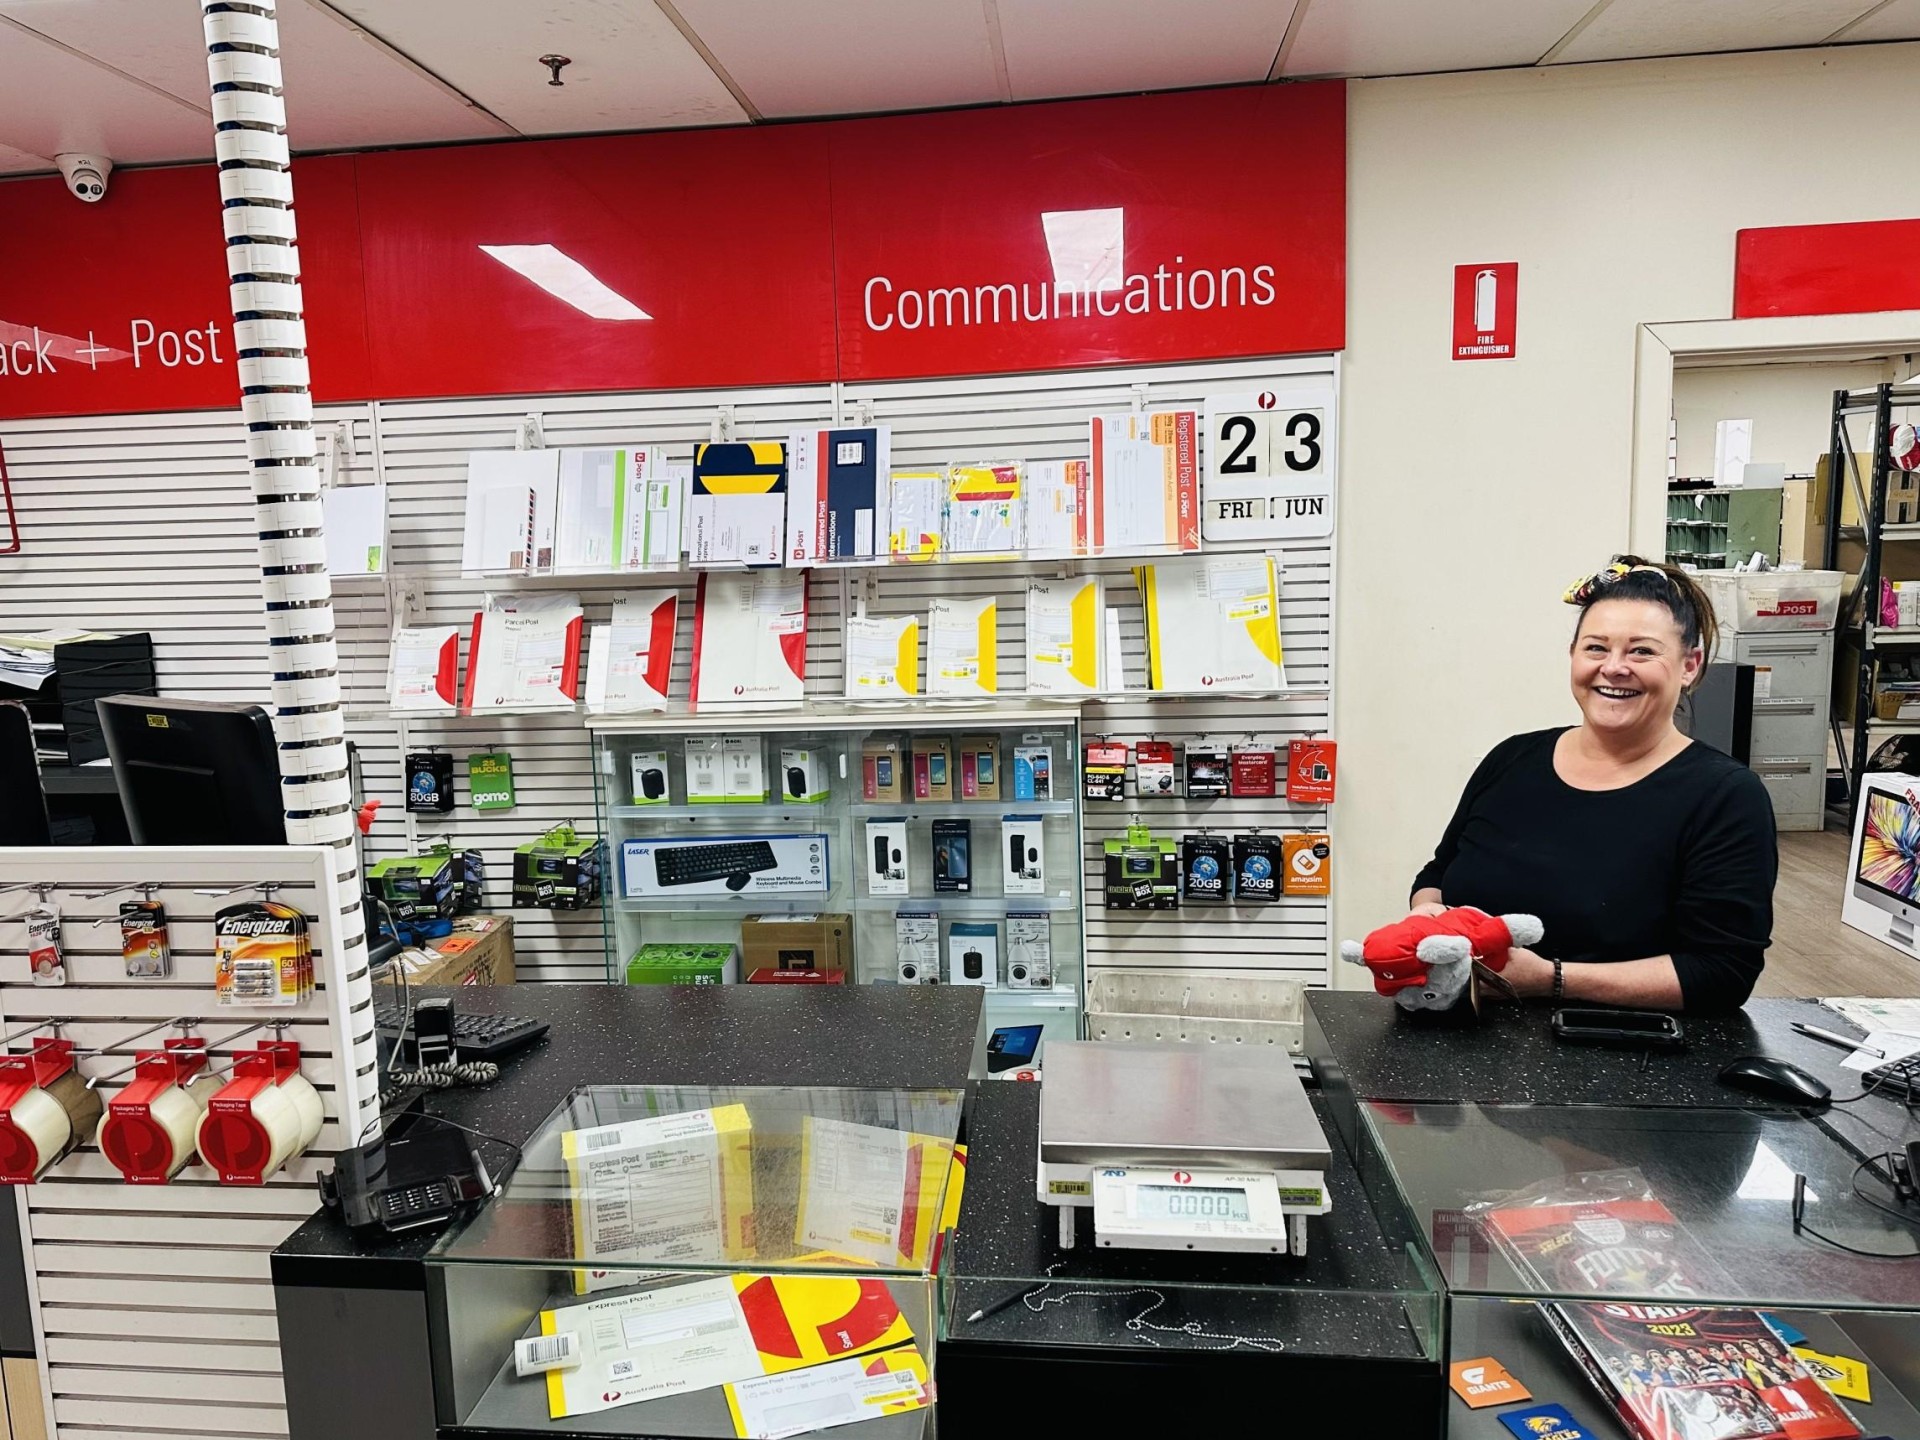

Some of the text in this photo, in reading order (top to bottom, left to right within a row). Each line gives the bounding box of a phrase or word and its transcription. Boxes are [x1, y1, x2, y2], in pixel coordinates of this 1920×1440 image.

[864, 256, 1277, 331] Communications
[130, 319, 224, 368] Post
[1477, 335, 1495, 345] FIRE
[1458, 345, 1510, 355] EXTINGUISHER
[1177, 415, 1192, 487] Registered Post
[1219, 498, 1324, 519] FRI JUN
[818, 500, 827, 561] Registered Post
[828, 511, 837, 560] International
[935, 605, 950, 613] Post
[1784, 605, 1814, 613] POST
[1215, 675, 1240, 683] Australia
[471, 766, 508, 774] BUCKS
[410, 792, 439, 802] 80GB
[473, 792, 510, 805] gomo
[1189, 878, 1222, 889] 20GB
[1241, 878, 1274, 889] 20GB
[1290, 876, 1323, 884] amaysim
[1136, 889, 1152, 897] BOX
[28, 919, 58, 933] Energizer
[122, 919, 155, 929] Energizer
[221, 918, 289, 937] Energizer
[589, 1156, 620, 1170] Express
[621, 1154, 640, 1164] Post
[1169, 1195, 1249, 1221] 0.000 kg
[1539, 1231, 1574, 1256] SELECT
[587, 1294, 652, 1312] Express Post
[1646, 1322, 1697, 1337] 2023
[624, 1379, 687, 1396] Australia Post
[1466, 1380, 1511, 1395] GIANTS
